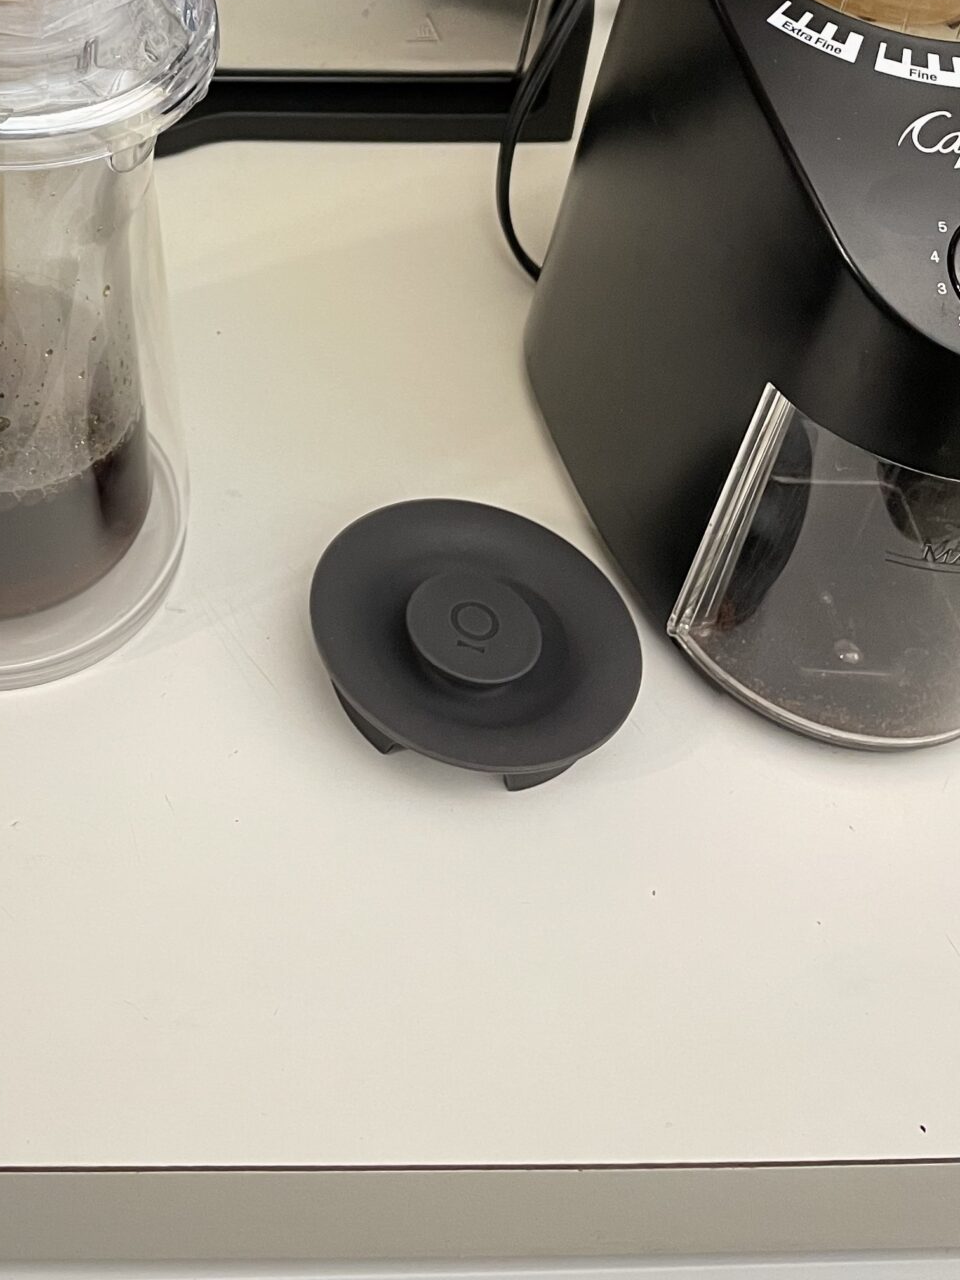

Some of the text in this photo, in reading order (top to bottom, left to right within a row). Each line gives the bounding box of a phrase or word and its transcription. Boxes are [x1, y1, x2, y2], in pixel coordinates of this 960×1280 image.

[781, 20, 843, 55] Extra Fine
[909, 68, 938, 82] Fine
[897, 110, 960, 170] Ca
[938, 221, 948, 233] 5
[930, 250, 940, 263] 4
[937, 282, 947, 295] 3
